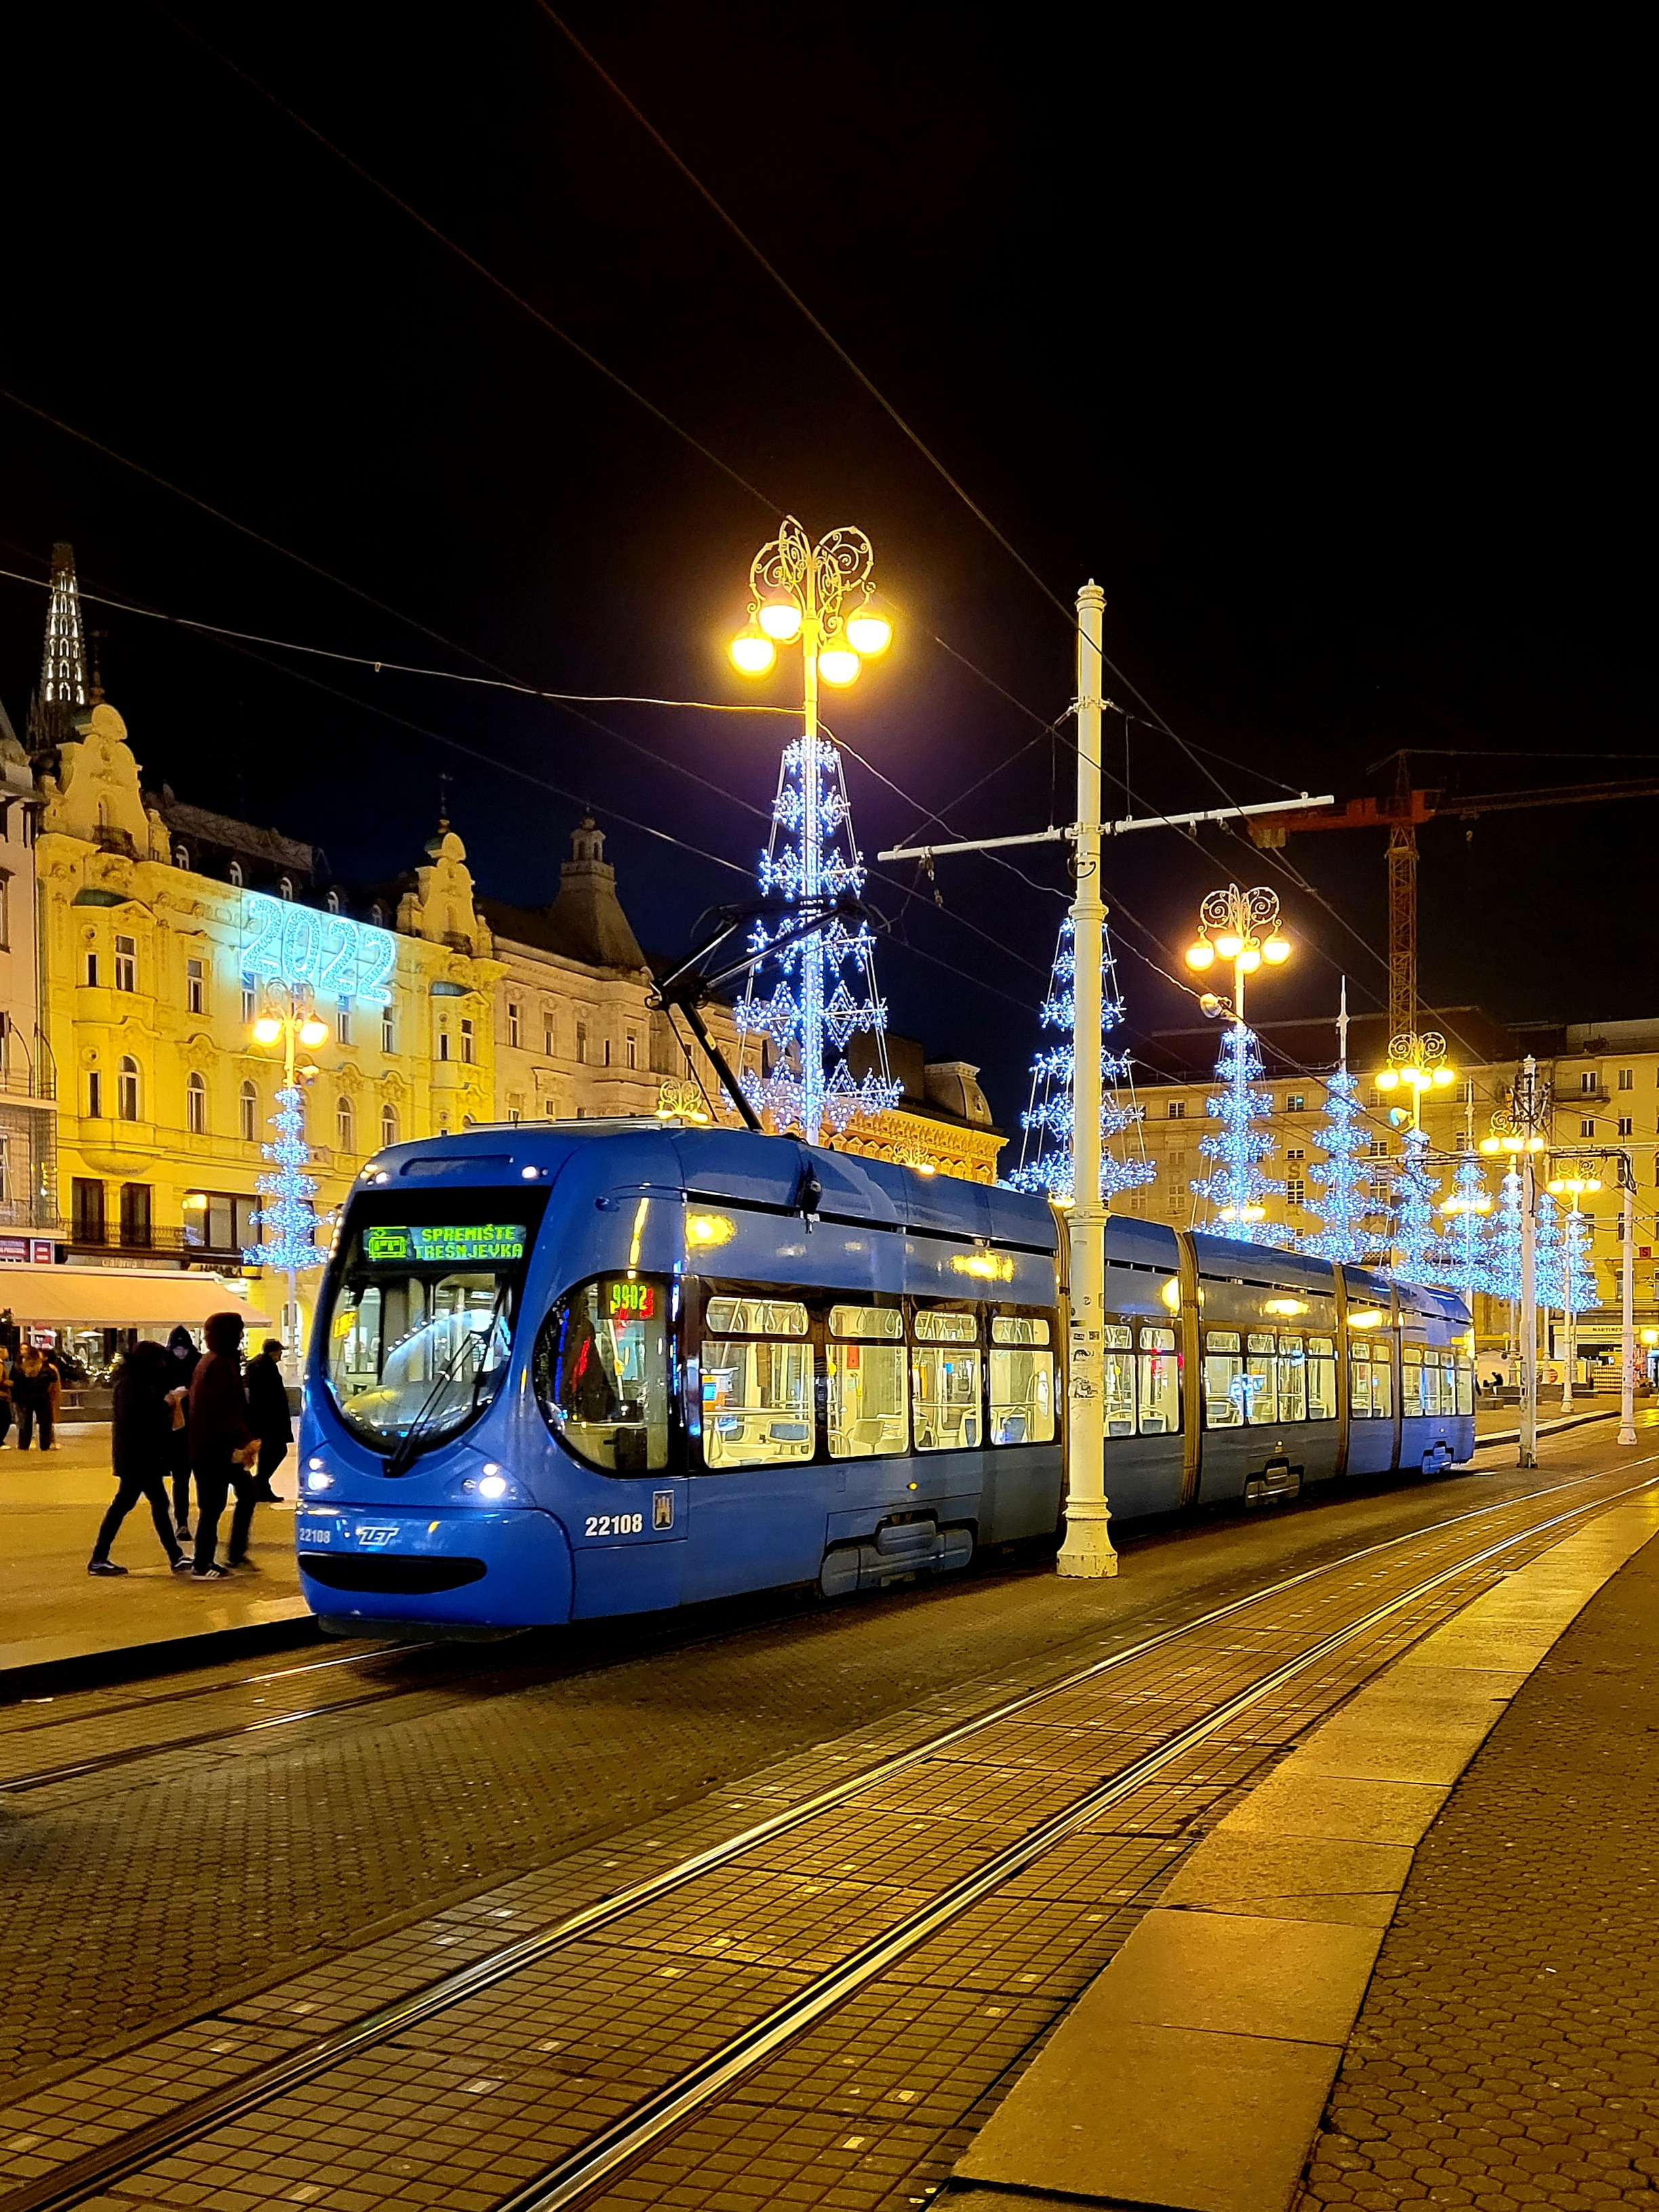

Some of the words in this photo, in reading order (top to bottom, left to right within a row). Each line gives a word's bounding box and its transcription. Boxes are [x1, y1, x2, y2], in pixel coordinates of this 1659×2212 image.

[240, 896, 396, 1006] 2022
[421, 1224, 516, 1242] SPREMIŠTE
[414, 1242, 523, 1260] TREŠNJEVKA
[584, 1513, 643, 1537] 22108
[299, 1527, 331, 1544] 22108
[358, 1527, 399, 1546] ZET
